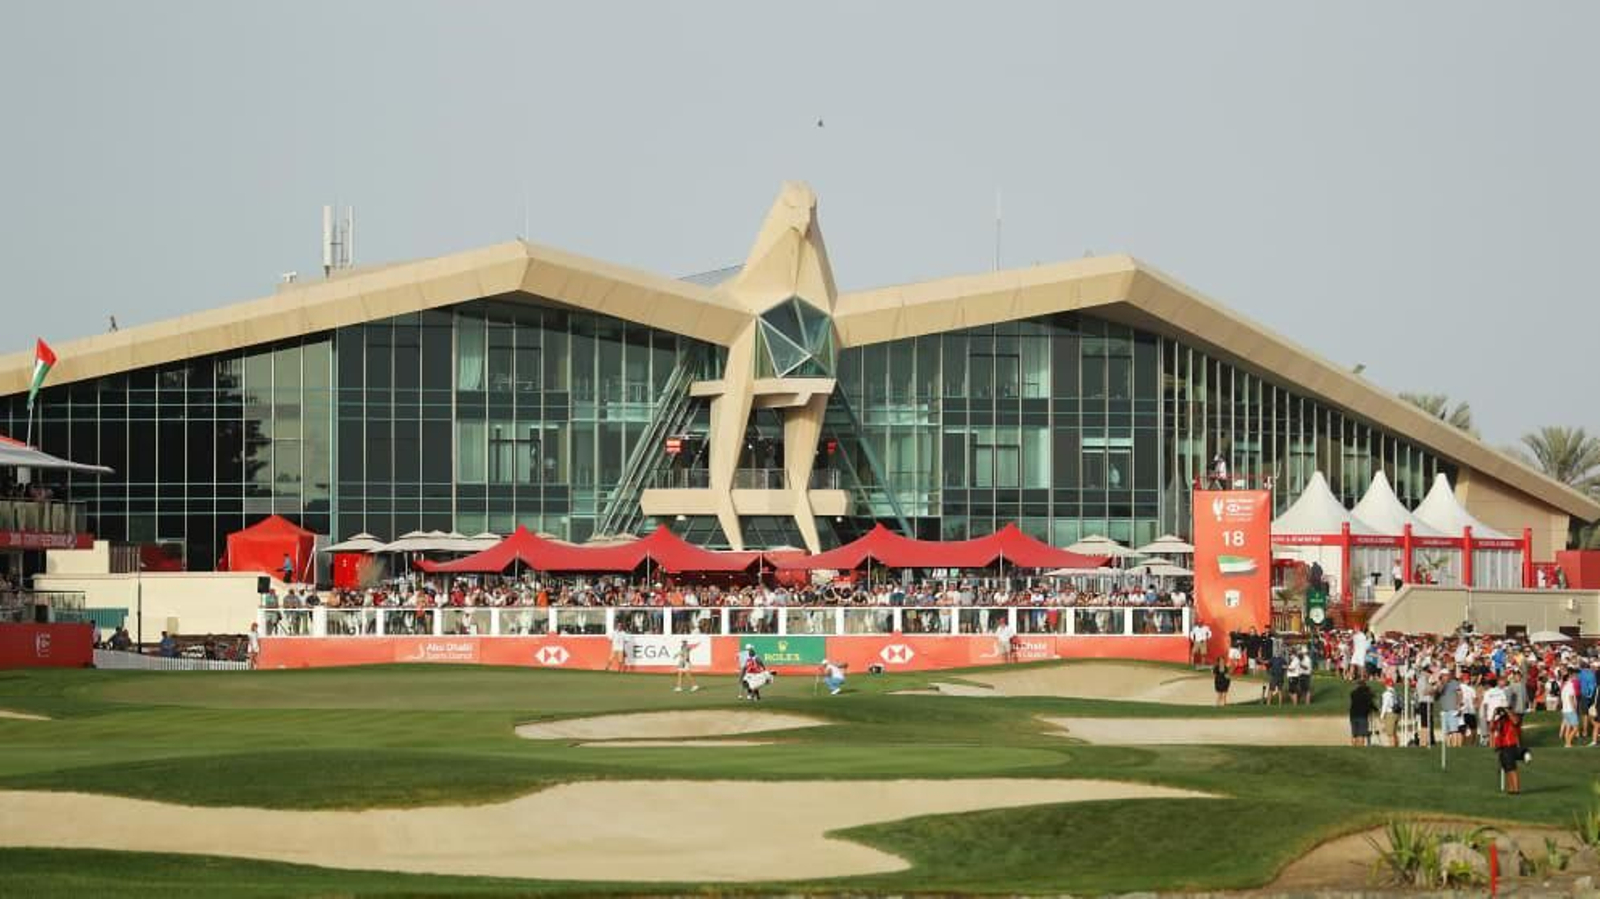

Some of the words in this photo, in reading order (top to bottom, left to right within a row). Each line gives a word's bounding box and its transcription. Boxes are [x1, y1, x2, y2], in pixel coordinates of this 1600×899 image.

[1222, 530, 1245, 547] 18
[632, 644, 671, 659] EGA
[764, 653, 800, 662] ROLEX
